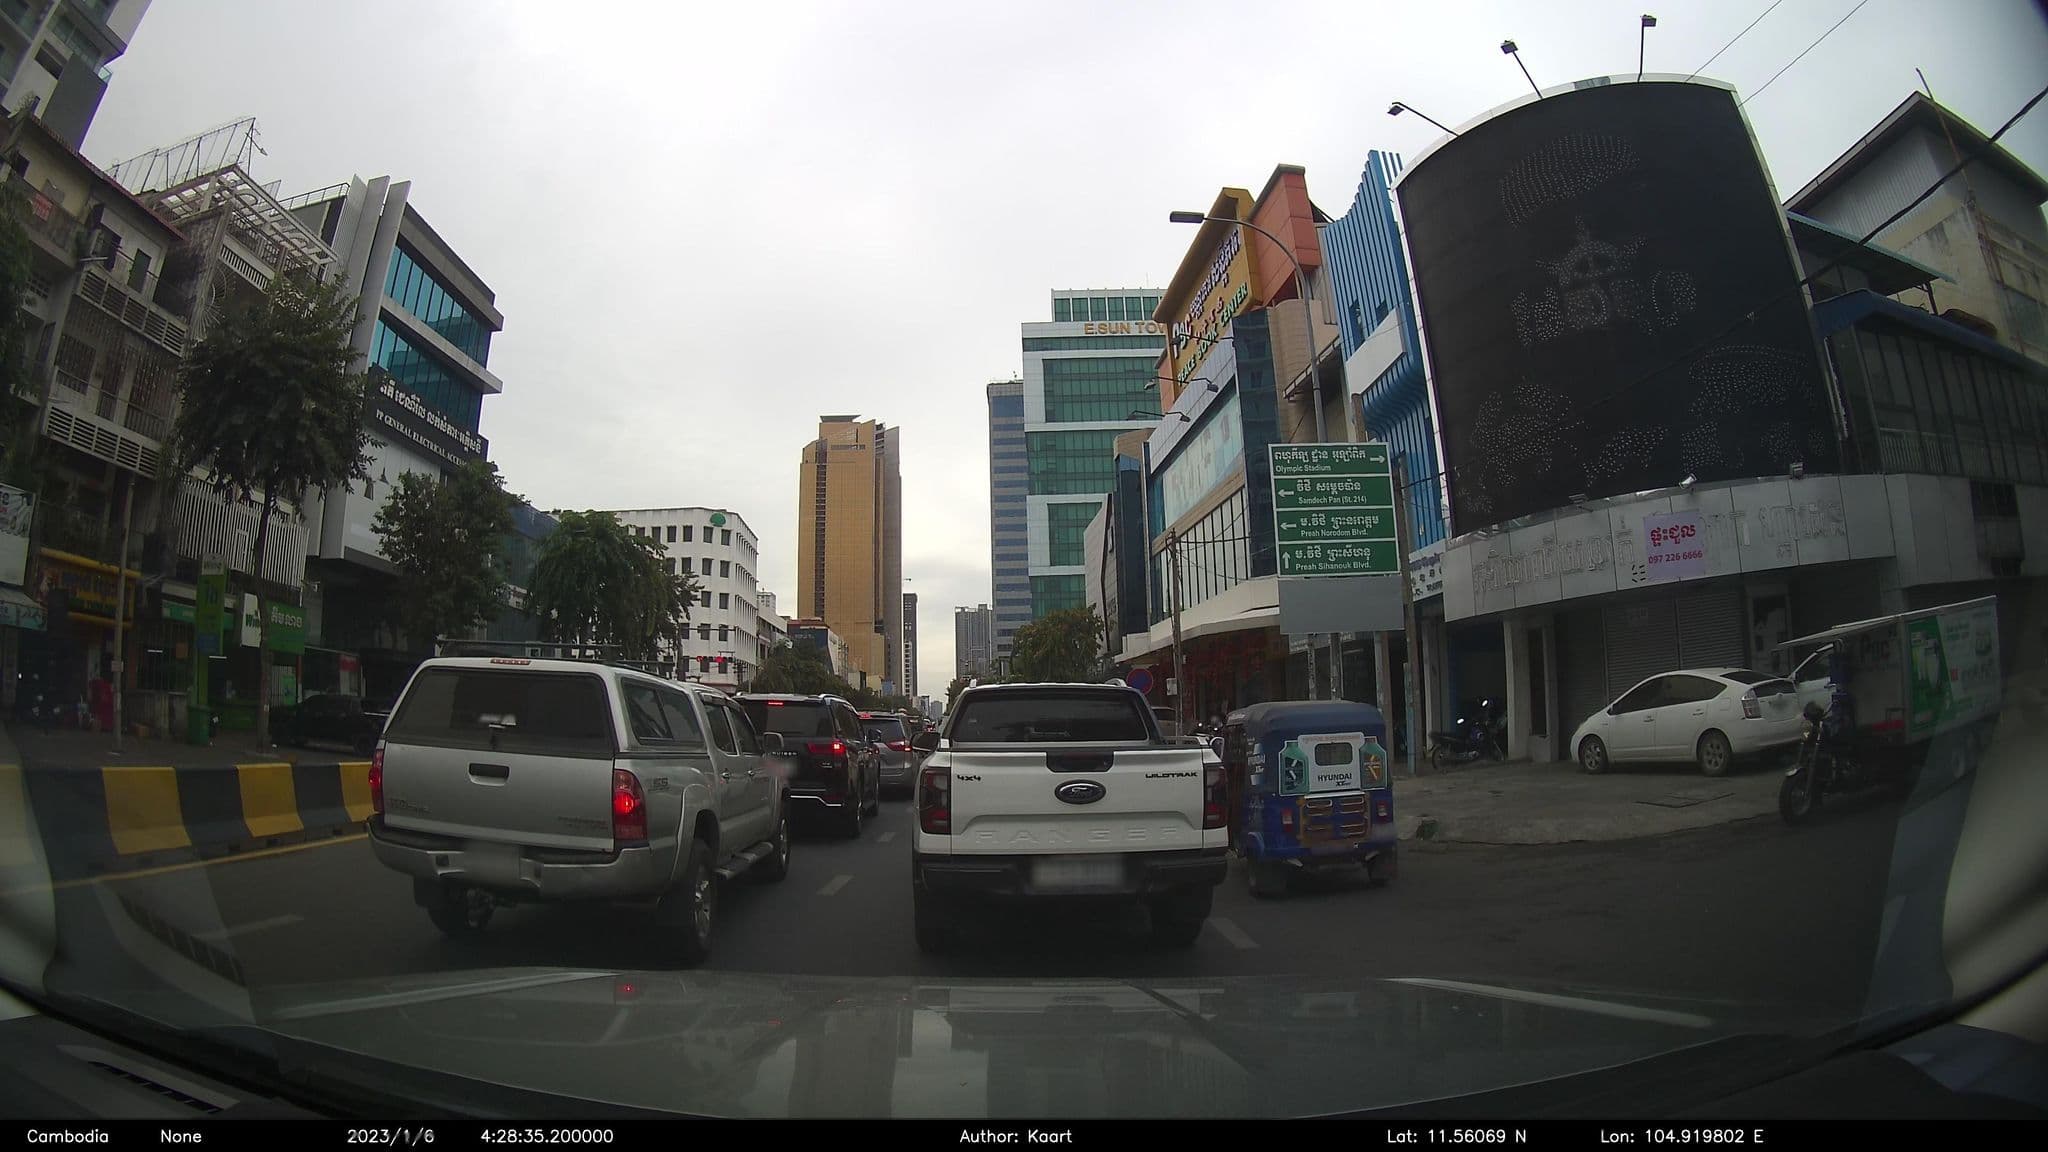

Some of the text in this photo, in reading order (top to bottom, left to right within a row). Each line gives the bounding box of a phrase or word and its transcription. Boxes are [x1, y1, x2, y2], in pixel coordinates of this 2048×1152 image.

[1197, 323, 1218, 361] BOOK
[1220, 282, 1249, 327] CENTER
[384, 414, 412, 437] GENERAL
[412, 431, 446, 458] ELECTRICAL
[1276, 464, 1332, 473] Olympic Stadium
[1353, 496, 1367, 504] 214)
[1300, 529, 1320, 537] Preah
[1352, 528, 1369, 536] Blvd.
[1648, 550, 1703, 564] 097 226 6666
[1296, 562, 1317, 570] Preah
[1353, 561, 1371, 569] Blvd.
[1146, 771, 1198, 779] WILDTRAK
[1317, 773, 1352, 782] HYUNDAI
